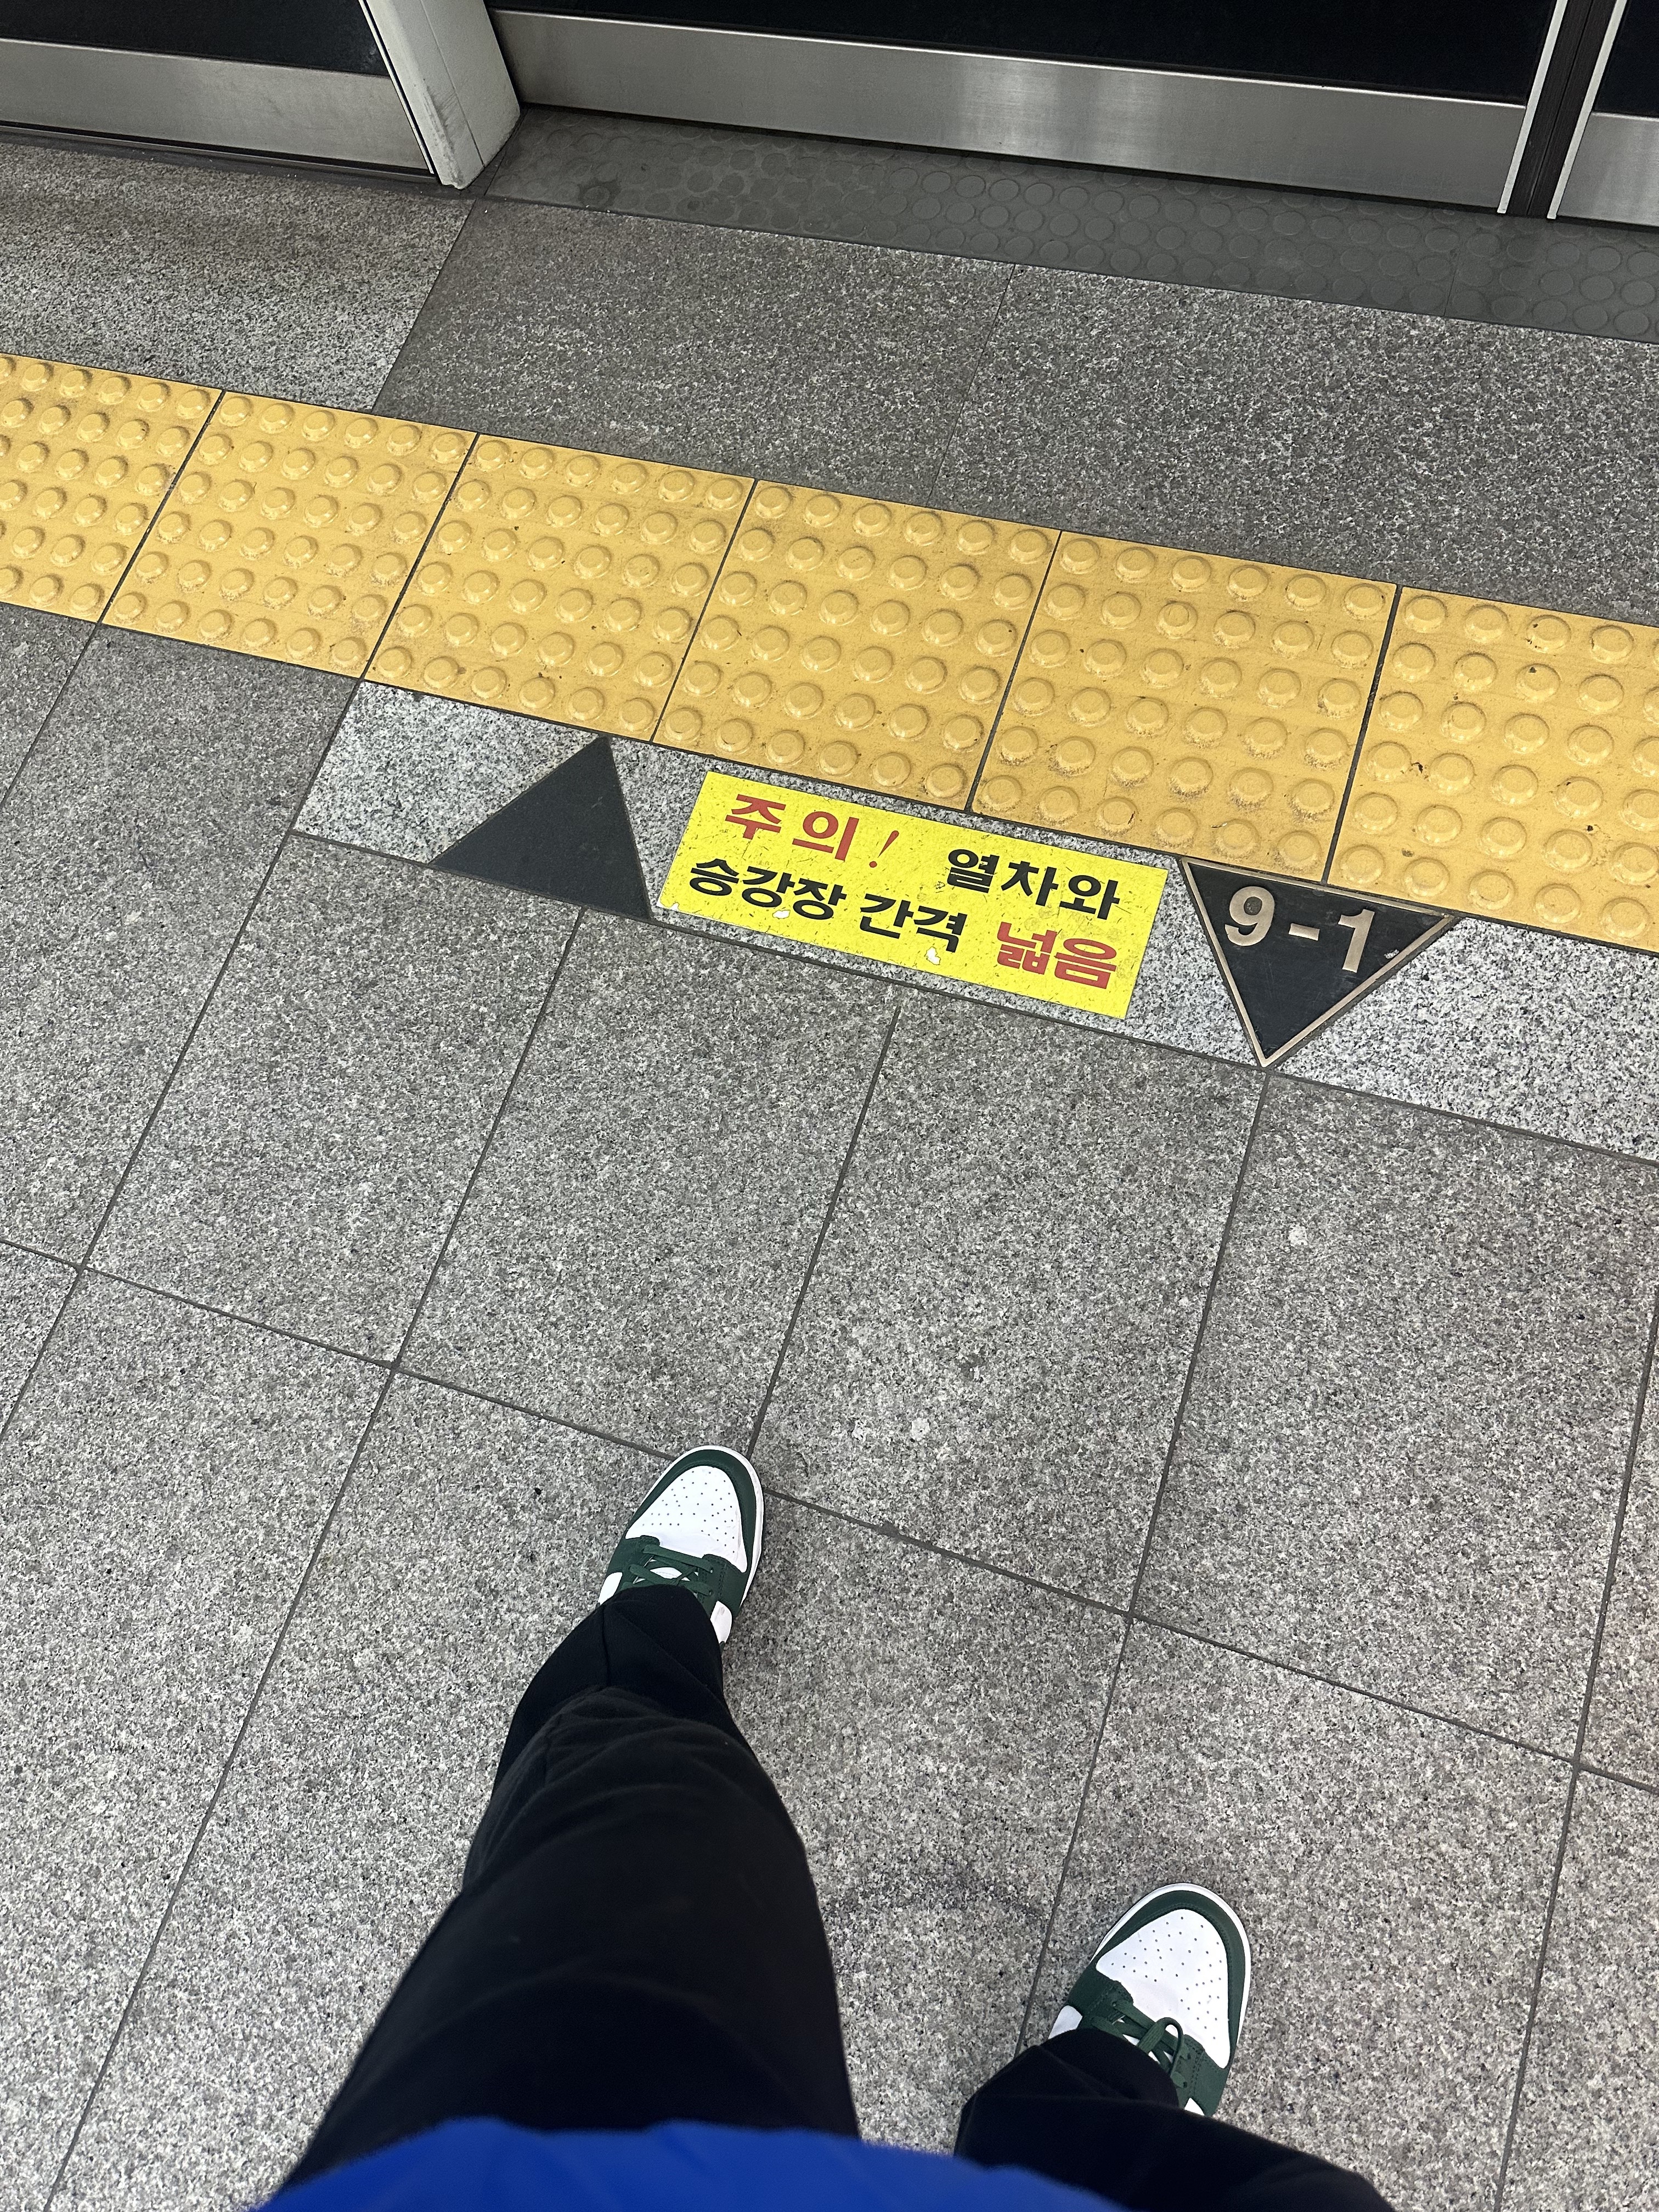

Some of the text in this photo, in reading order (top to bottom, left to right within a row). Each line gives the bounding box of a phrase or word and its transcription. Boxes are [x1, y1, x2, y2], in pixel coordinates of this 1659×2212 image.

[689, 857, 1119, 990] 승강장 간격 넓음
[945, 849, 1121, 921] 열차와
[1224, 885, 1375, 973] 9-1
